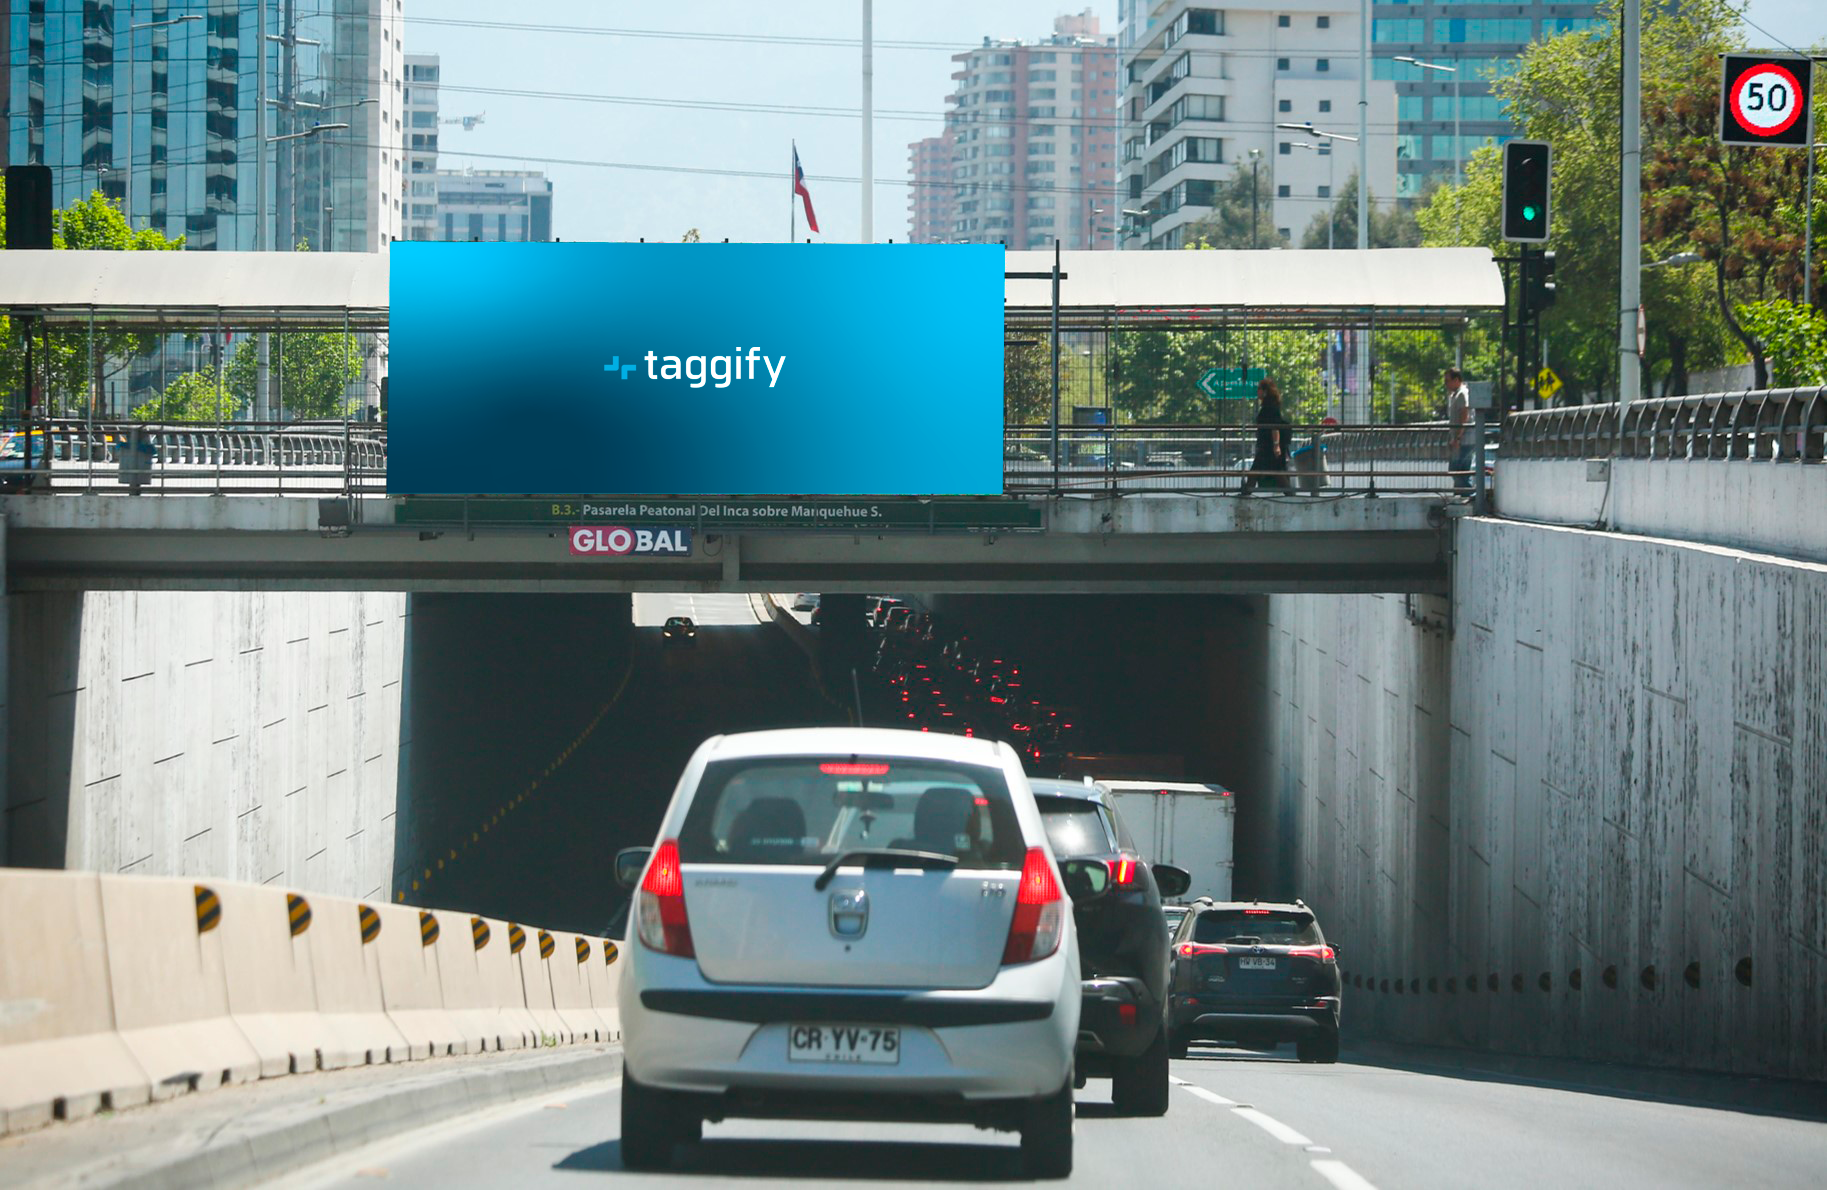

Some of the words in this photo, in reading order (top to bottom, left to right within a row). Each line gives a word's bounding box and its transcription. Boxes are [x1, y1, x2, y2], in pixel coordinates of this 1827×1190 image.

[1747, 82, 1787, 111] 50
[644, 346, 787, 389] taggify
[583, 504, 637, 516] Pasarela
[640, 504, 696, 517] Peatonal
[700, 504, 720, 517] Del
[723, 505, 750, 517] Inca
[752, 505, 789, 517] sobre
[791, 505, 868, 520] Manquehue
[870, 505, 883, 518] S.
[572, 529, 688, 553] GLOBAL
